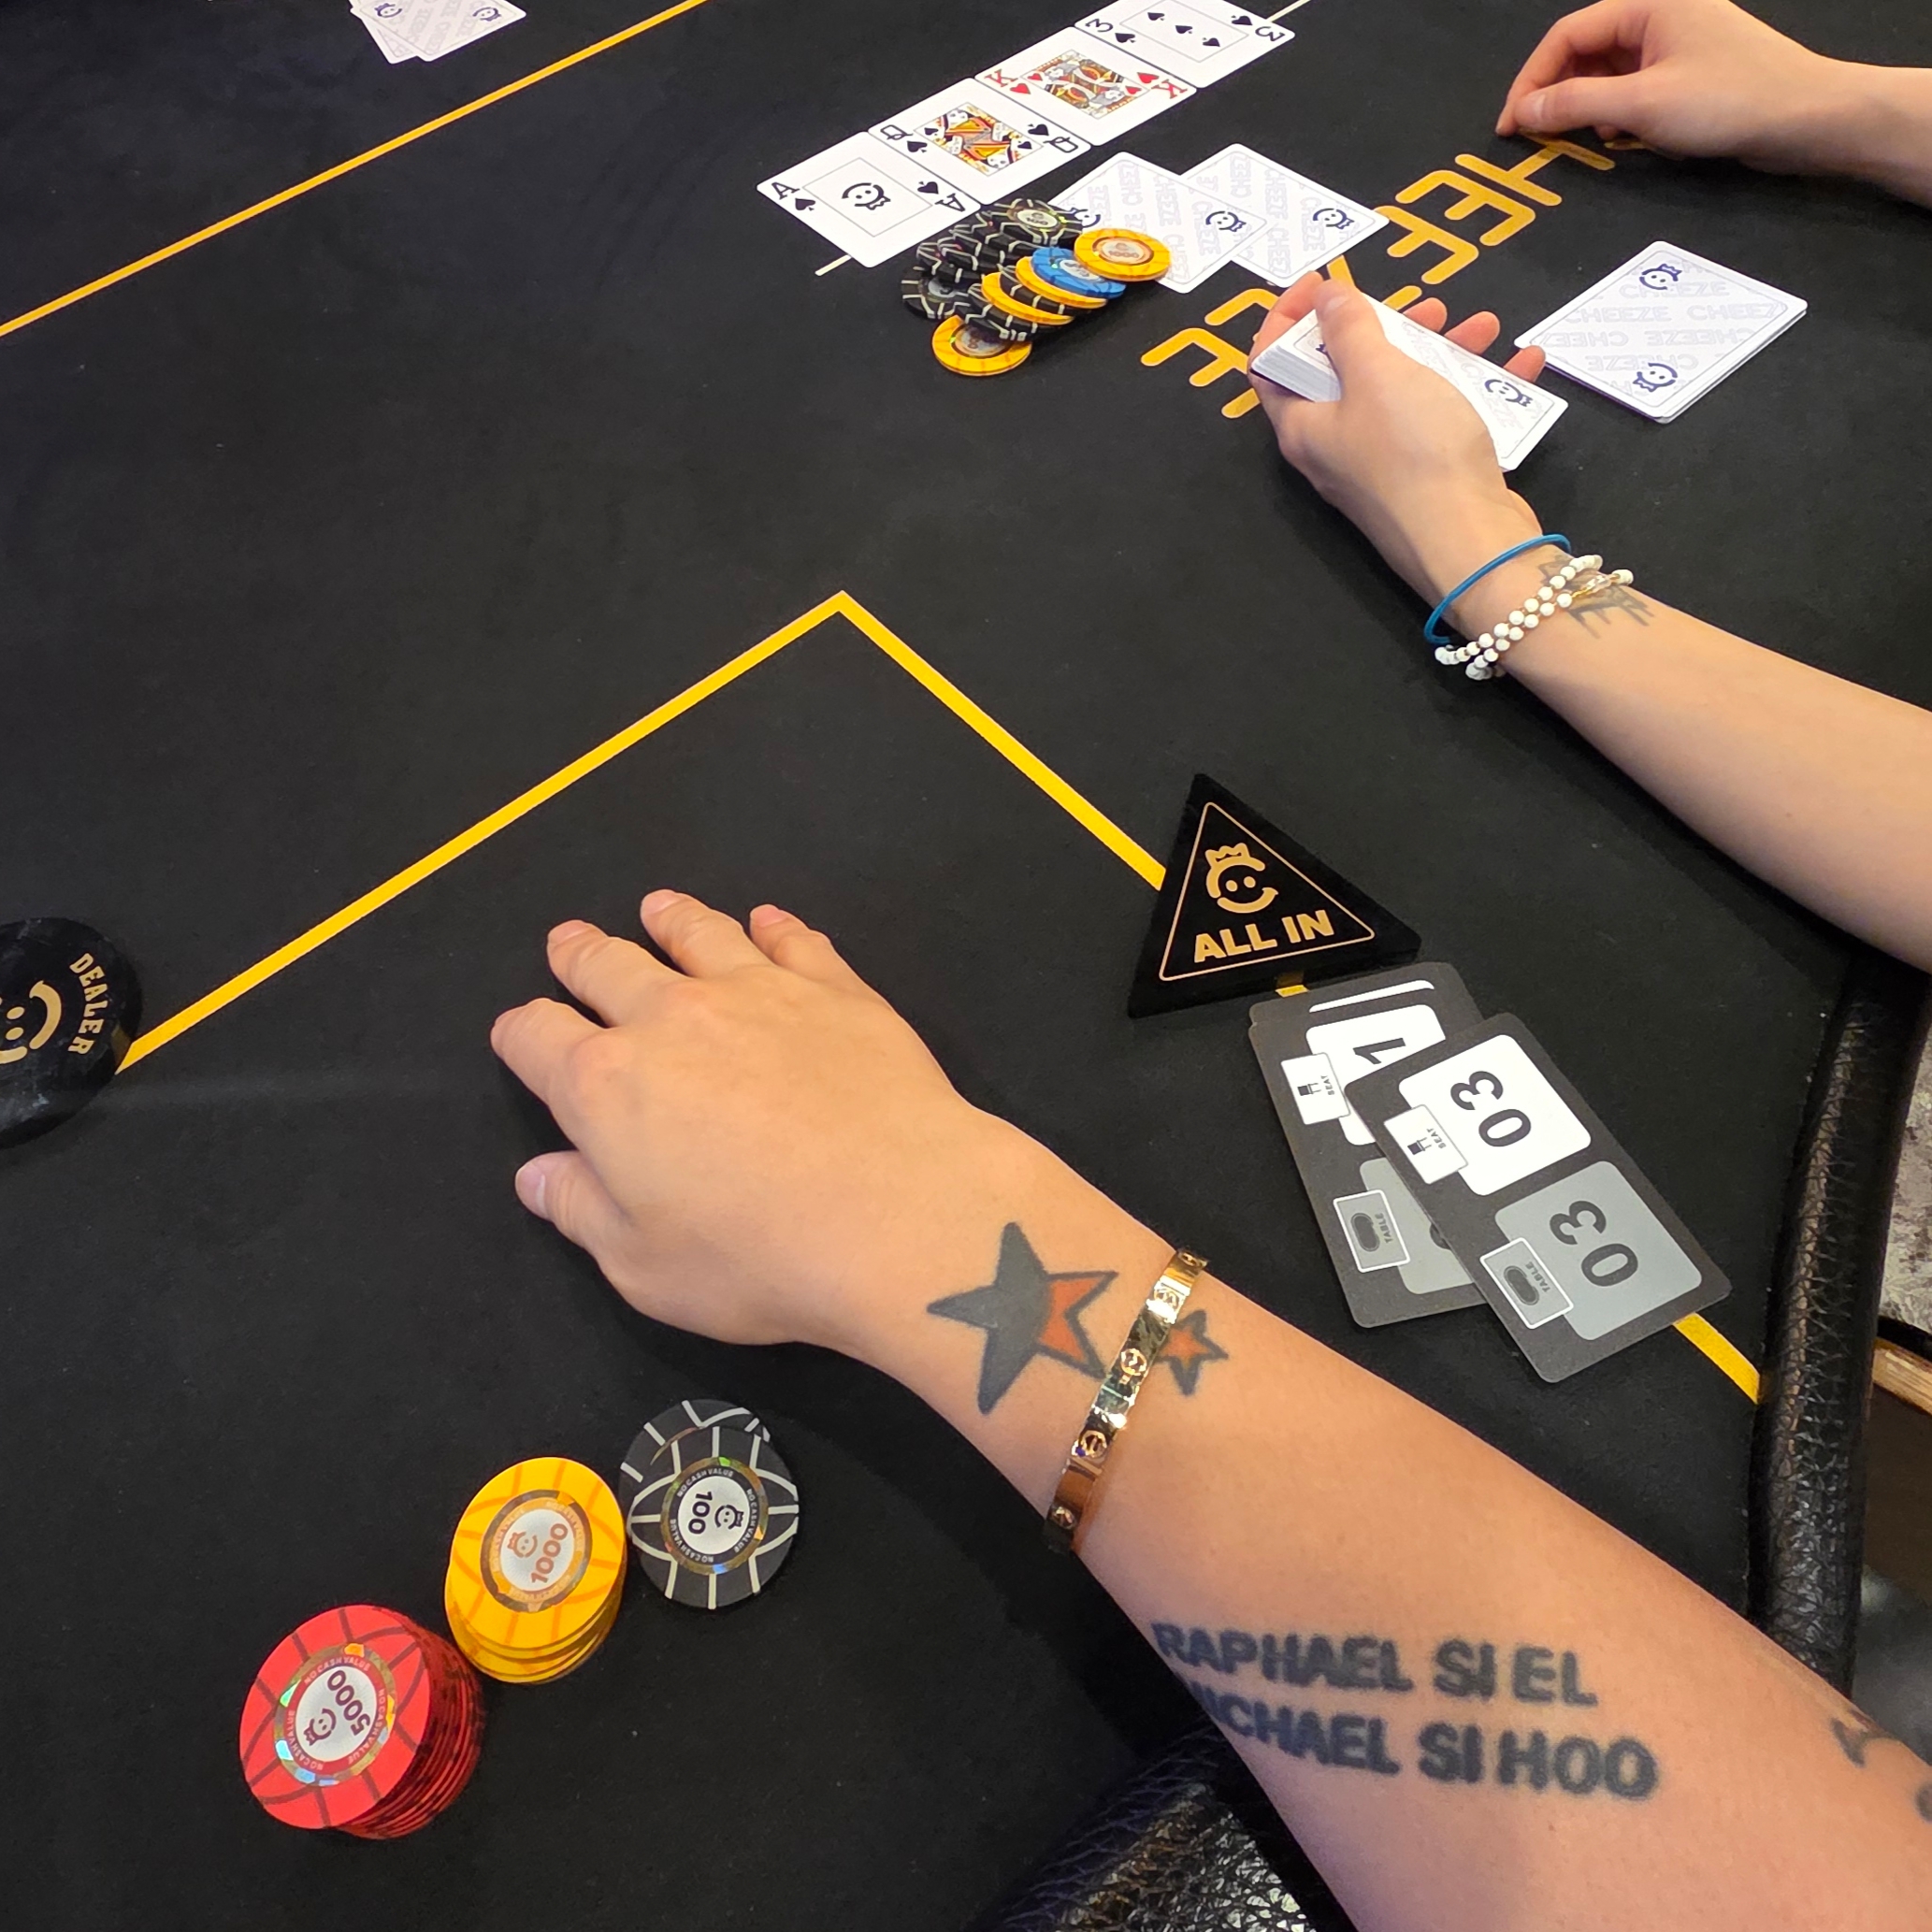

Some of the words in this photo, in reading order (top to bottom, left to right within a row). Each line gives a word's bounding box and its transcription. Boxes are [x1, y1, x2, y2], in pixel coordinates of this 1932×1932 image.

[1085, 18, 1114, 33] 3
[1255, 25, 1286, 42] 3
[985, 69, 1018, 87] K
[1152, 79, 1188, 99] K
[880, 124, 913, 141] Q
[1044, 137, 1078, 152] Q
[771, 182, 800, 199] A
[935, 194, 965, 212] A
[1193, 923, 1278, 963] ALL
[1281, 909, 1334, 944] IN
[68, 952, 108, 1055] DEALER
[1320, 1075, 1335, 1096] SEAT
[1450, 1071, 1532, 1147] 03
[1426, 1128, 1447, 1149] SEAT
[1375, 1213, 1393, 1244] TABLE
[1550, 1201, 1638, 1287] 03
[1525, 1262, 1550, 1292] TABLE
[708, 1468, 734, 1478] VALUE
[688, 1491, 713, 1535] 100
[530, 1522, 569, 1584] 1000
[343, 1656, 371, 1672] VALUE
[1150, 1622, 1413, 1693] RAPHAEL
[327, 1670, 371, 1737] 5000
